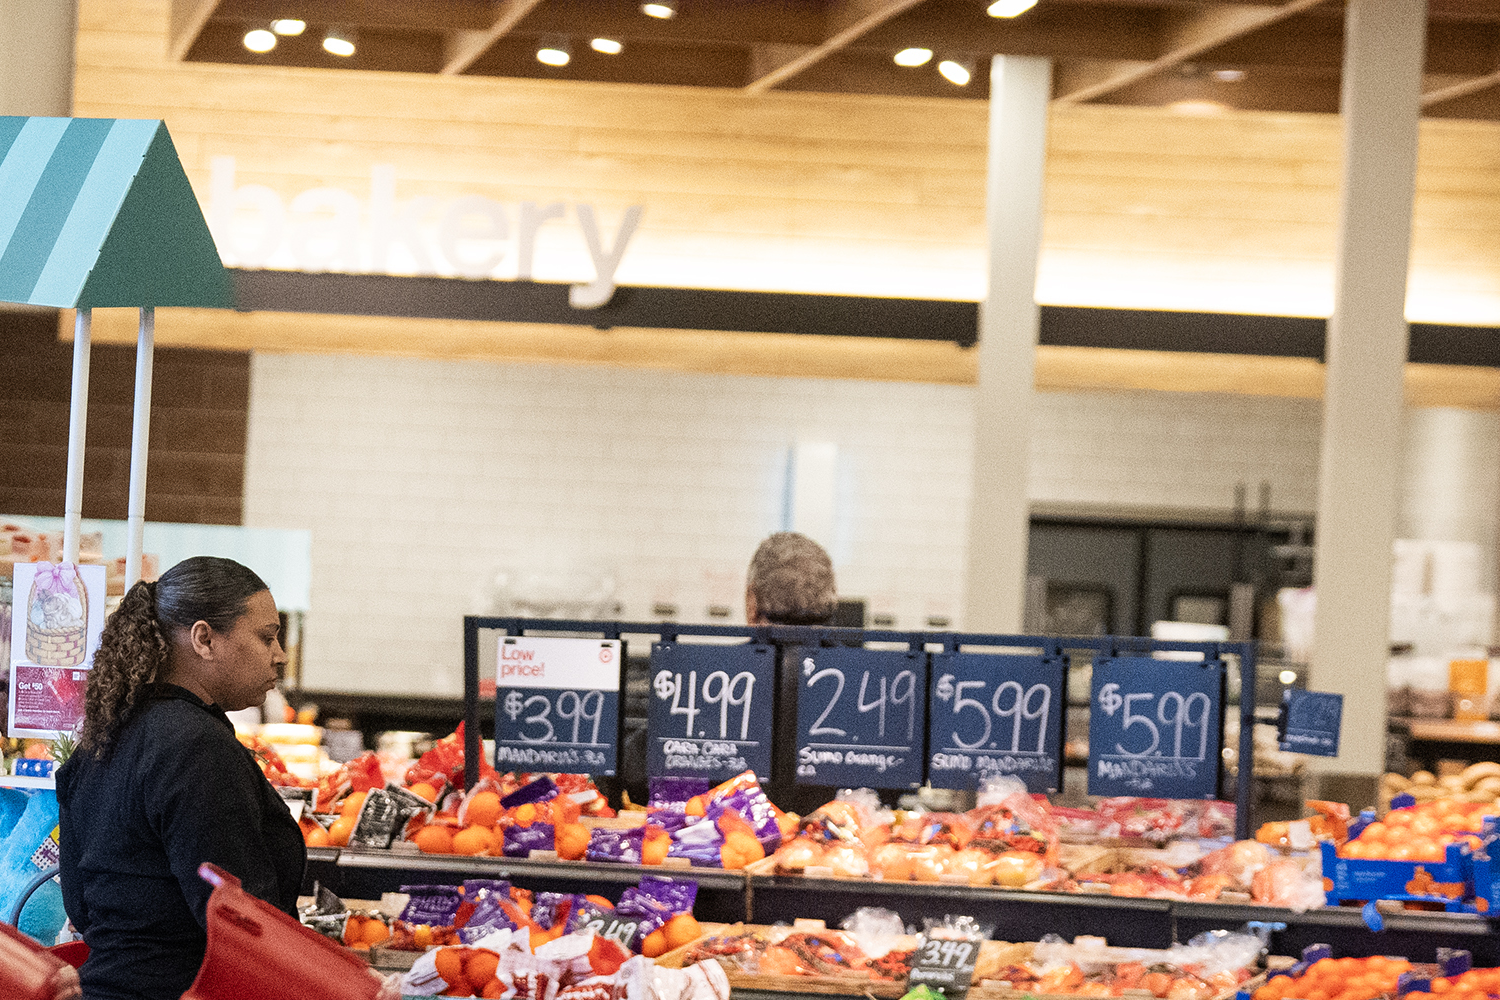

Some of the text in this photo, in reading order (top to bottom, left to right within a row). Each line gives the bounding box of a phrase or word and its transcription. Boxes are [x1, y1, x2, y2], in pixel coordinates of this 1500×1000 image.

[209, 155, 647, 309] bakery
[501, 646, 535, 661] Low
[501, 661, 546, 678] price!
[18, 681, 31, 690] Get
[653, 669, 757, 740] $4.99
[503, 690, 605, 745] $3.99
[936, 673, 1052, 754] $5.99
[1099, 683, 1211, 760] $5.99
[799, 746, 844, 764] Sumo
